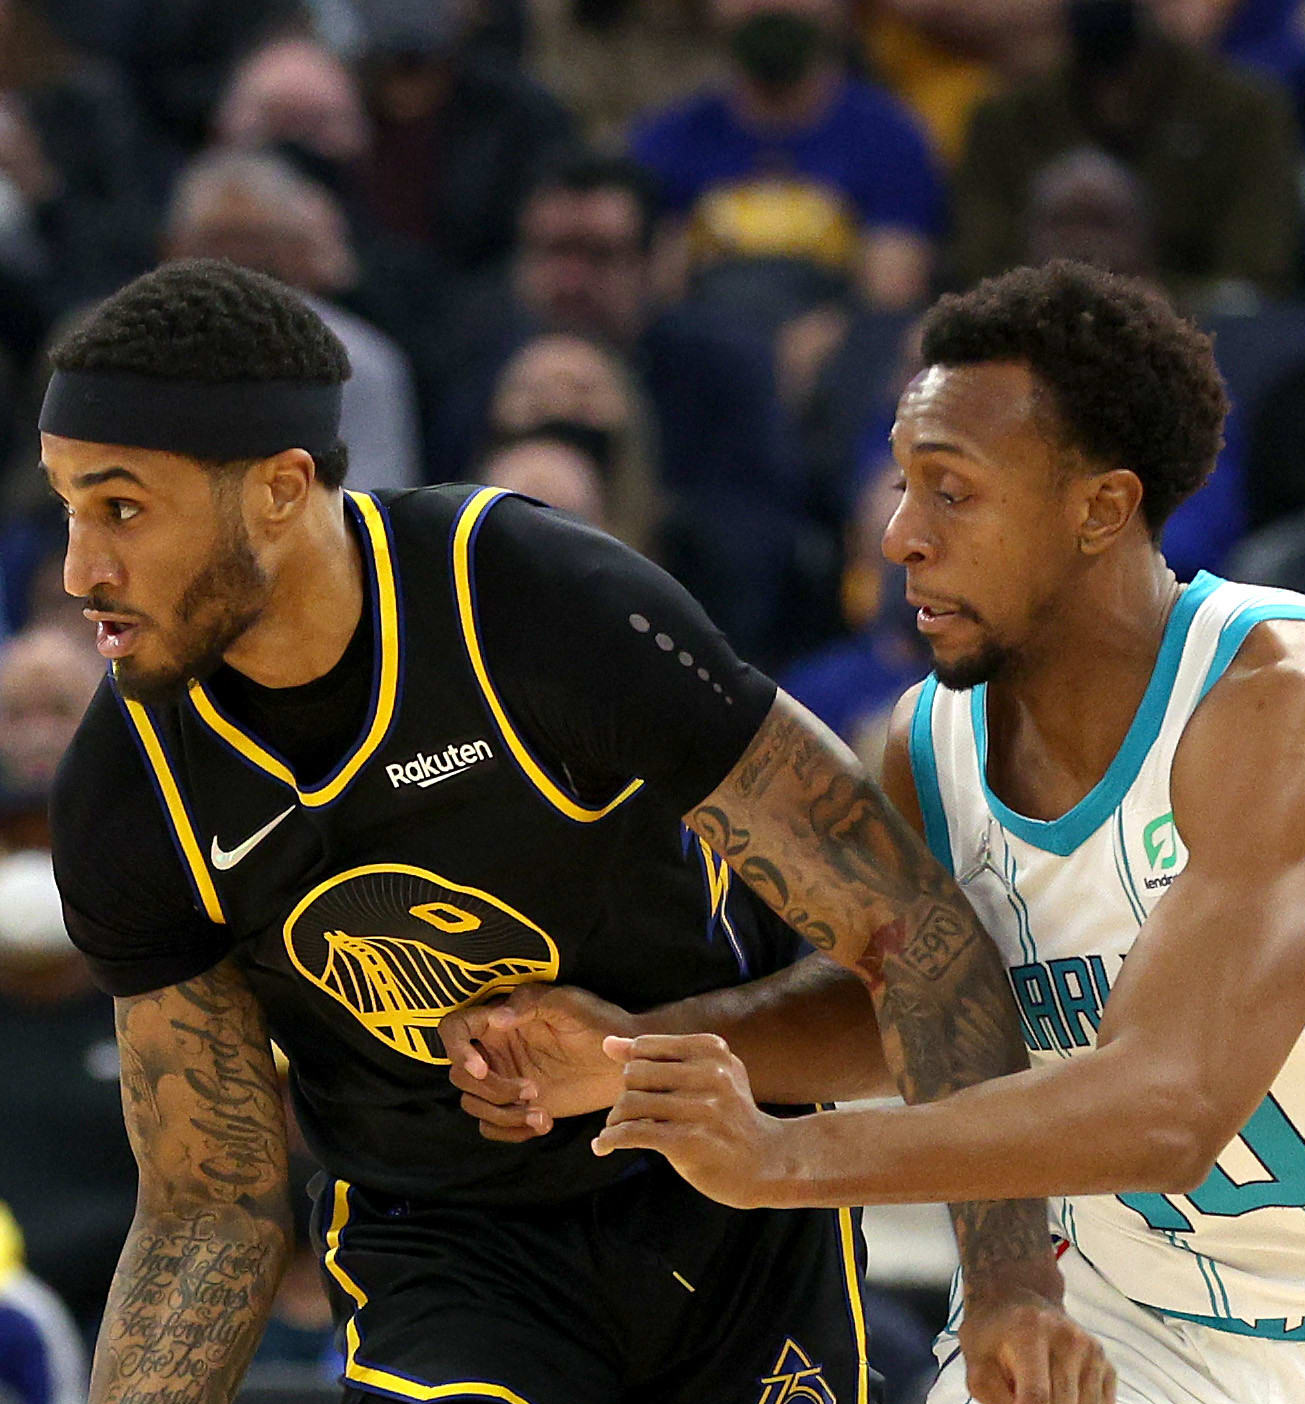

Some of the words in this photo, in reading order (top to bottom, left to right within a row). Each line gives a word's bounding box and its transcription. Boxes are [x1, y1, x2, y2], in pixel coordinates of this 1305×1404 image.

[385, 740, 493, 788] Rakuten
[1143, 873, 1179, 890] lendr
[409, 902, 482, 933] 0
